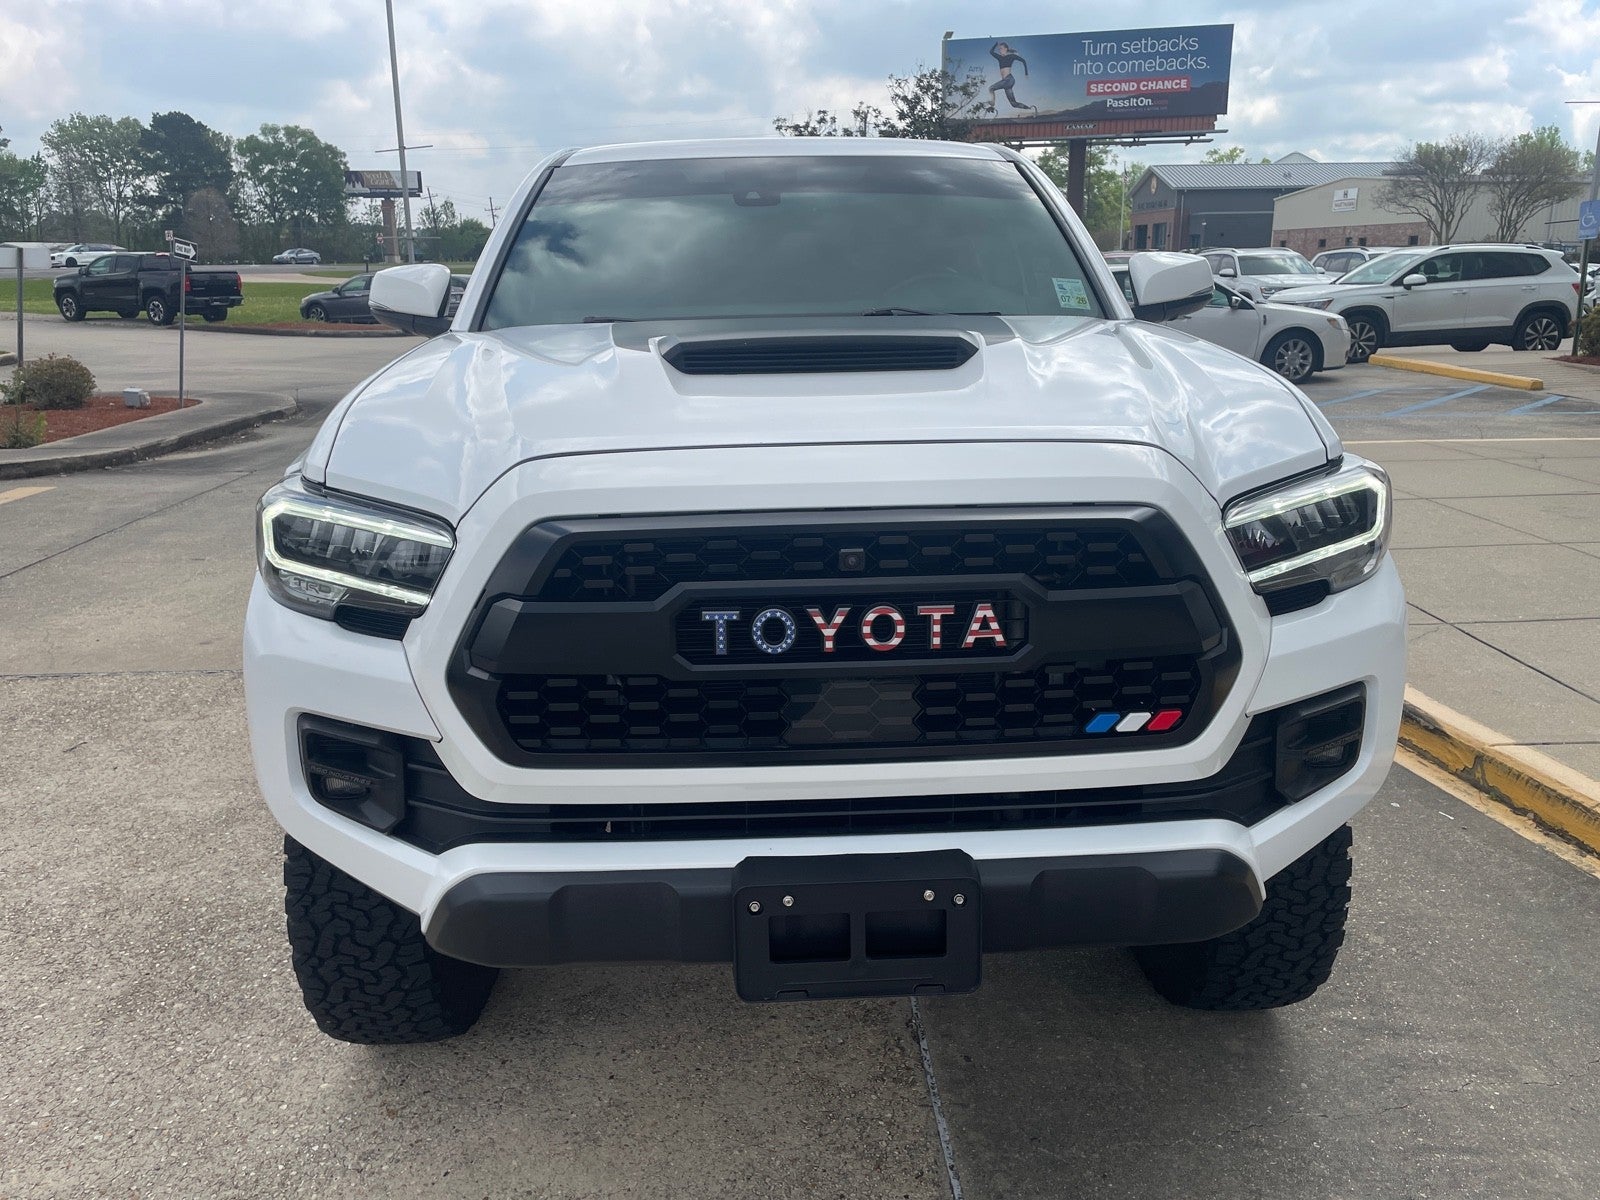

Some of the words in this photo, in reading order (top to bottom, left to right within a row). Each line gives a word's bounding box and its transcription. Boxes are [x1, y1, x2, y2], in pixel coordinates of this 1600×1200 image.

[1082, 39, 1117, 56] Turn
[1120, 34, 1199, 55] setbacks
[1073, 59, 1103, 76] into
[1107, 53, 1211, 74] comebacks.
[1090, 82, 1137, 93] SECOND
[1140, 79, 1188, 91] CHANCE
[293, 577, 331, 594] TRD
[701, 602, 1008, 656] TOYOTA
